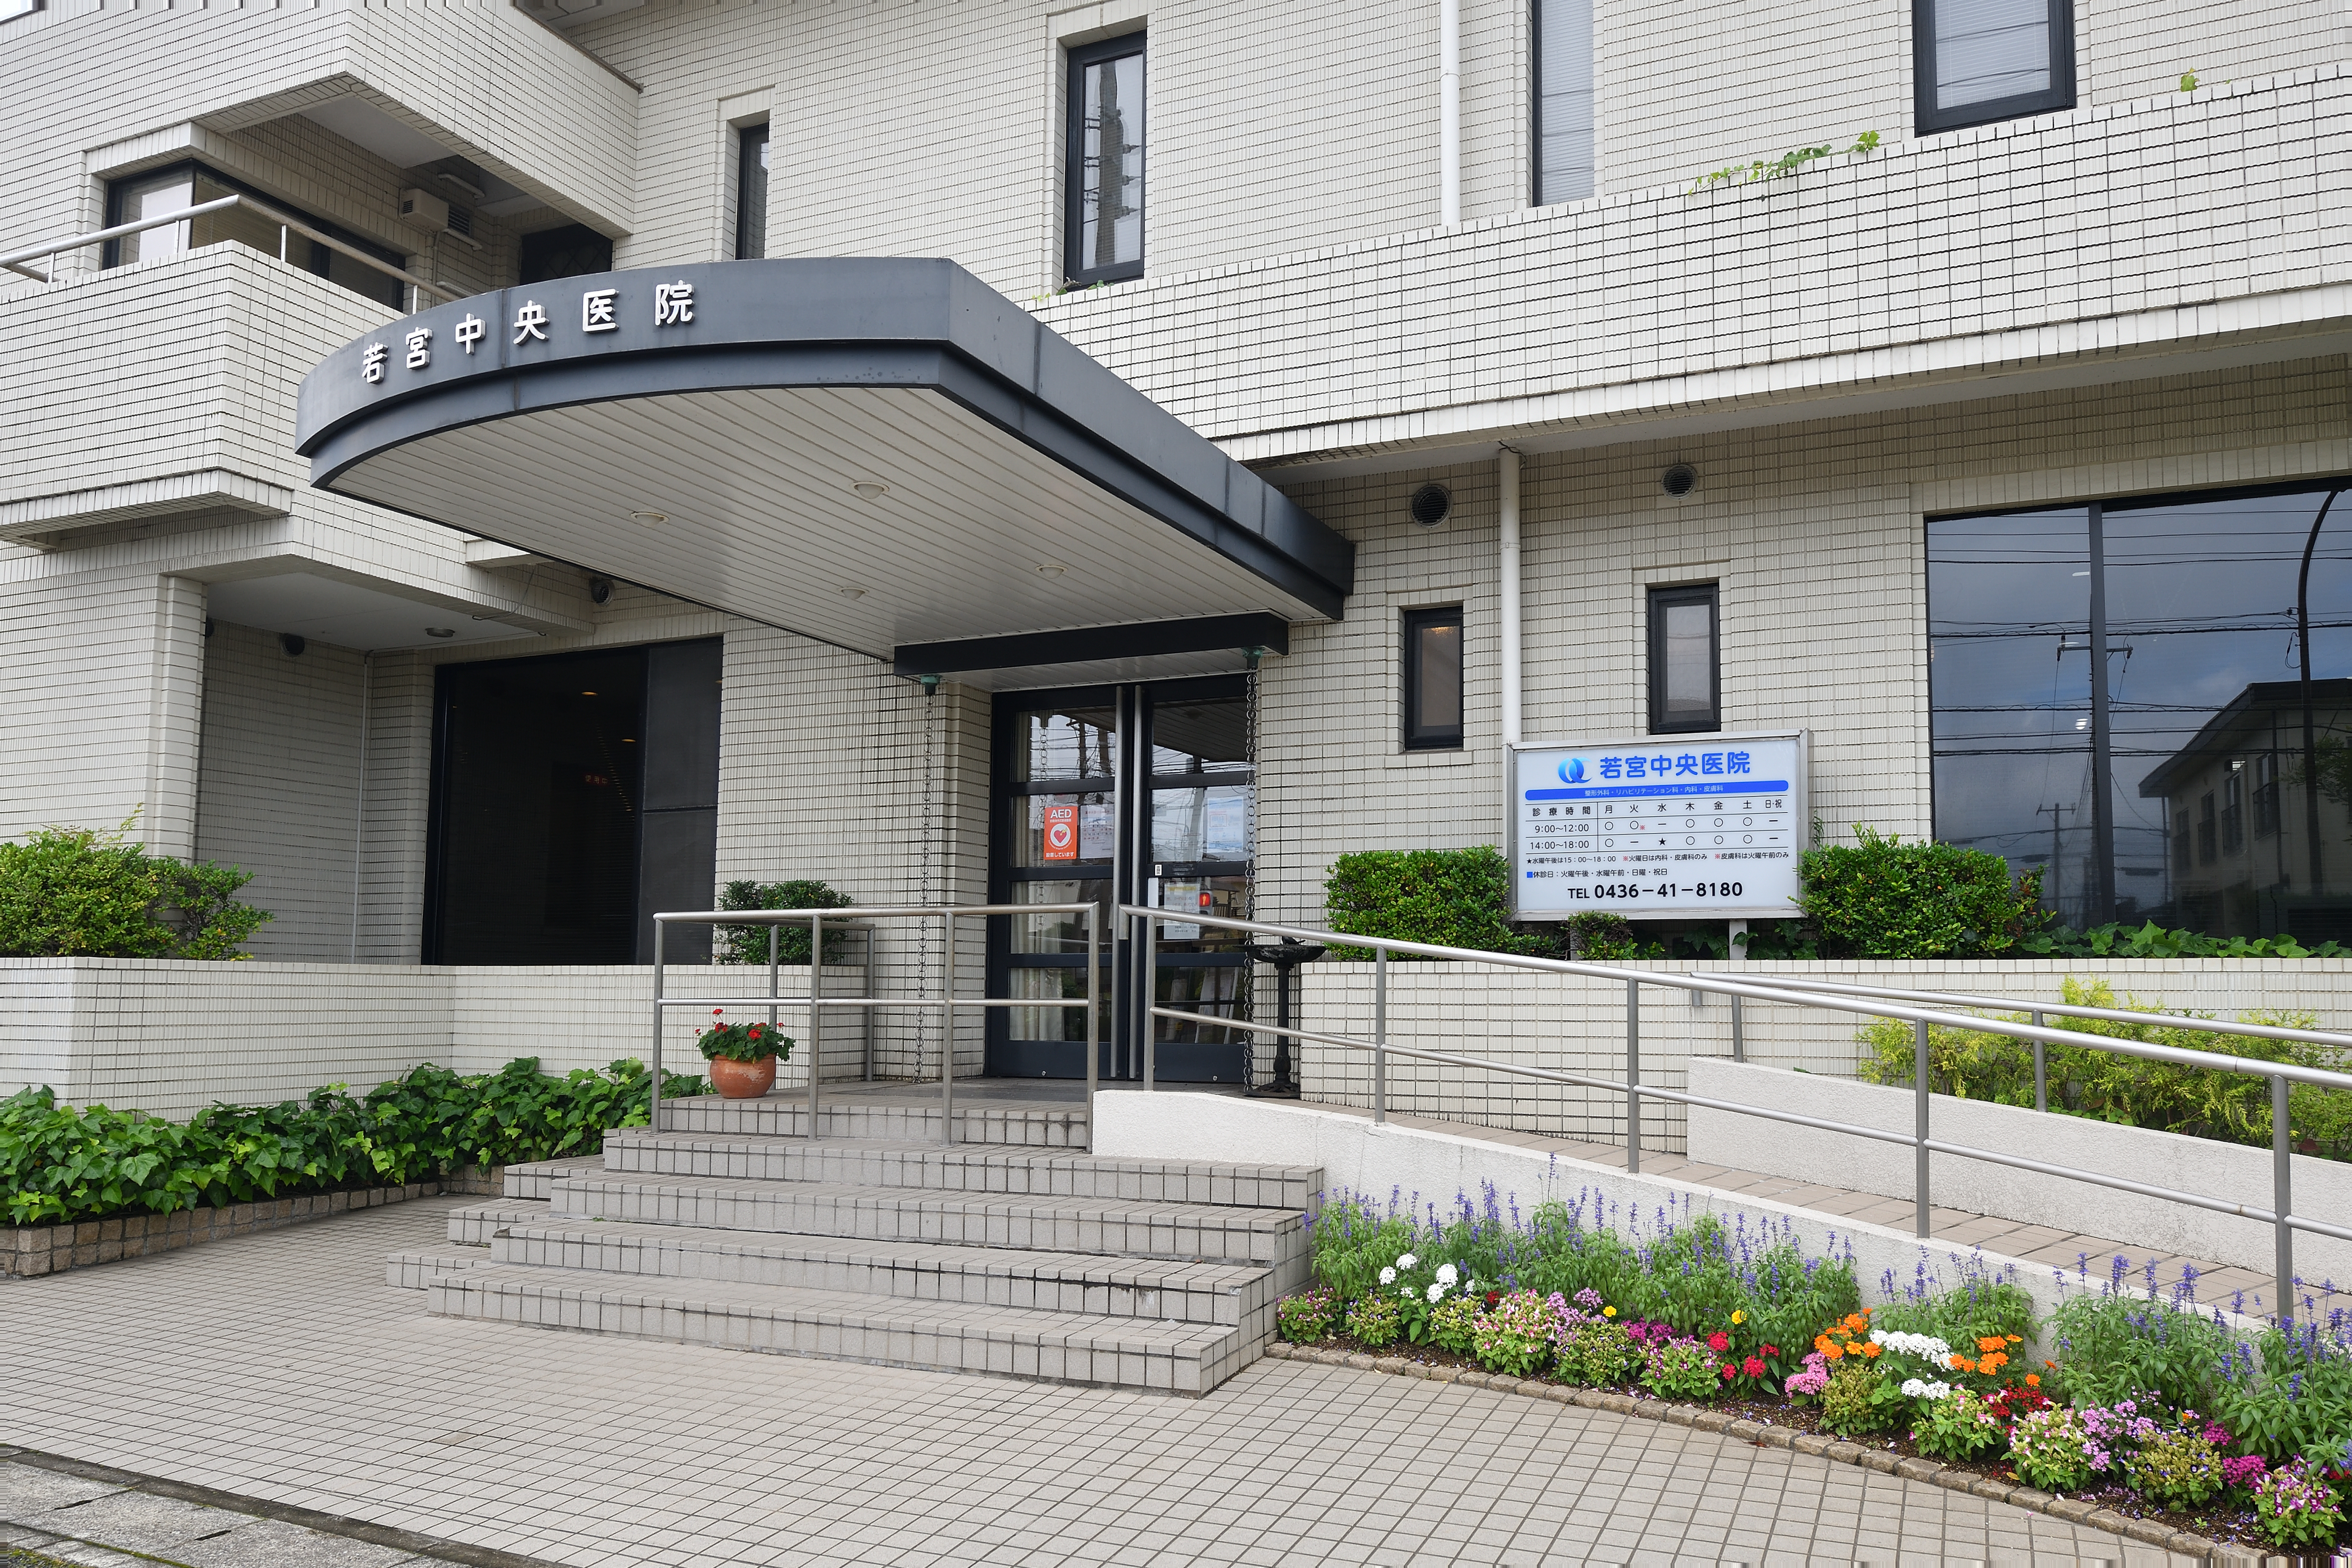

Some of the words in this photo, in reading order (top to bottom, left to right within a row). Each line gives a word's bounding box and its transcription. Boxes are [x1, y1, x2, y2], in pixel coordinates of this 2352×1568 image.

[361, 279, 696, 385] 若宮中央医院
[1599, 751, 1751, 779] 若宮中央医院
[1050, 809, 1072, 819] AED
[1532, 806, 1591, 817] 診療時間
[1604, 805, 1613, 814] 月
[1630, 804, 1639, 813] 火
[1657, 803, 1667, 812] 水
[1685, 802, 1695, 811] 木
[1714, 801, 1723, 810] 金
[1743, 800, 1752, 809] 土
[1567, 888, 1590, 899] TEL
